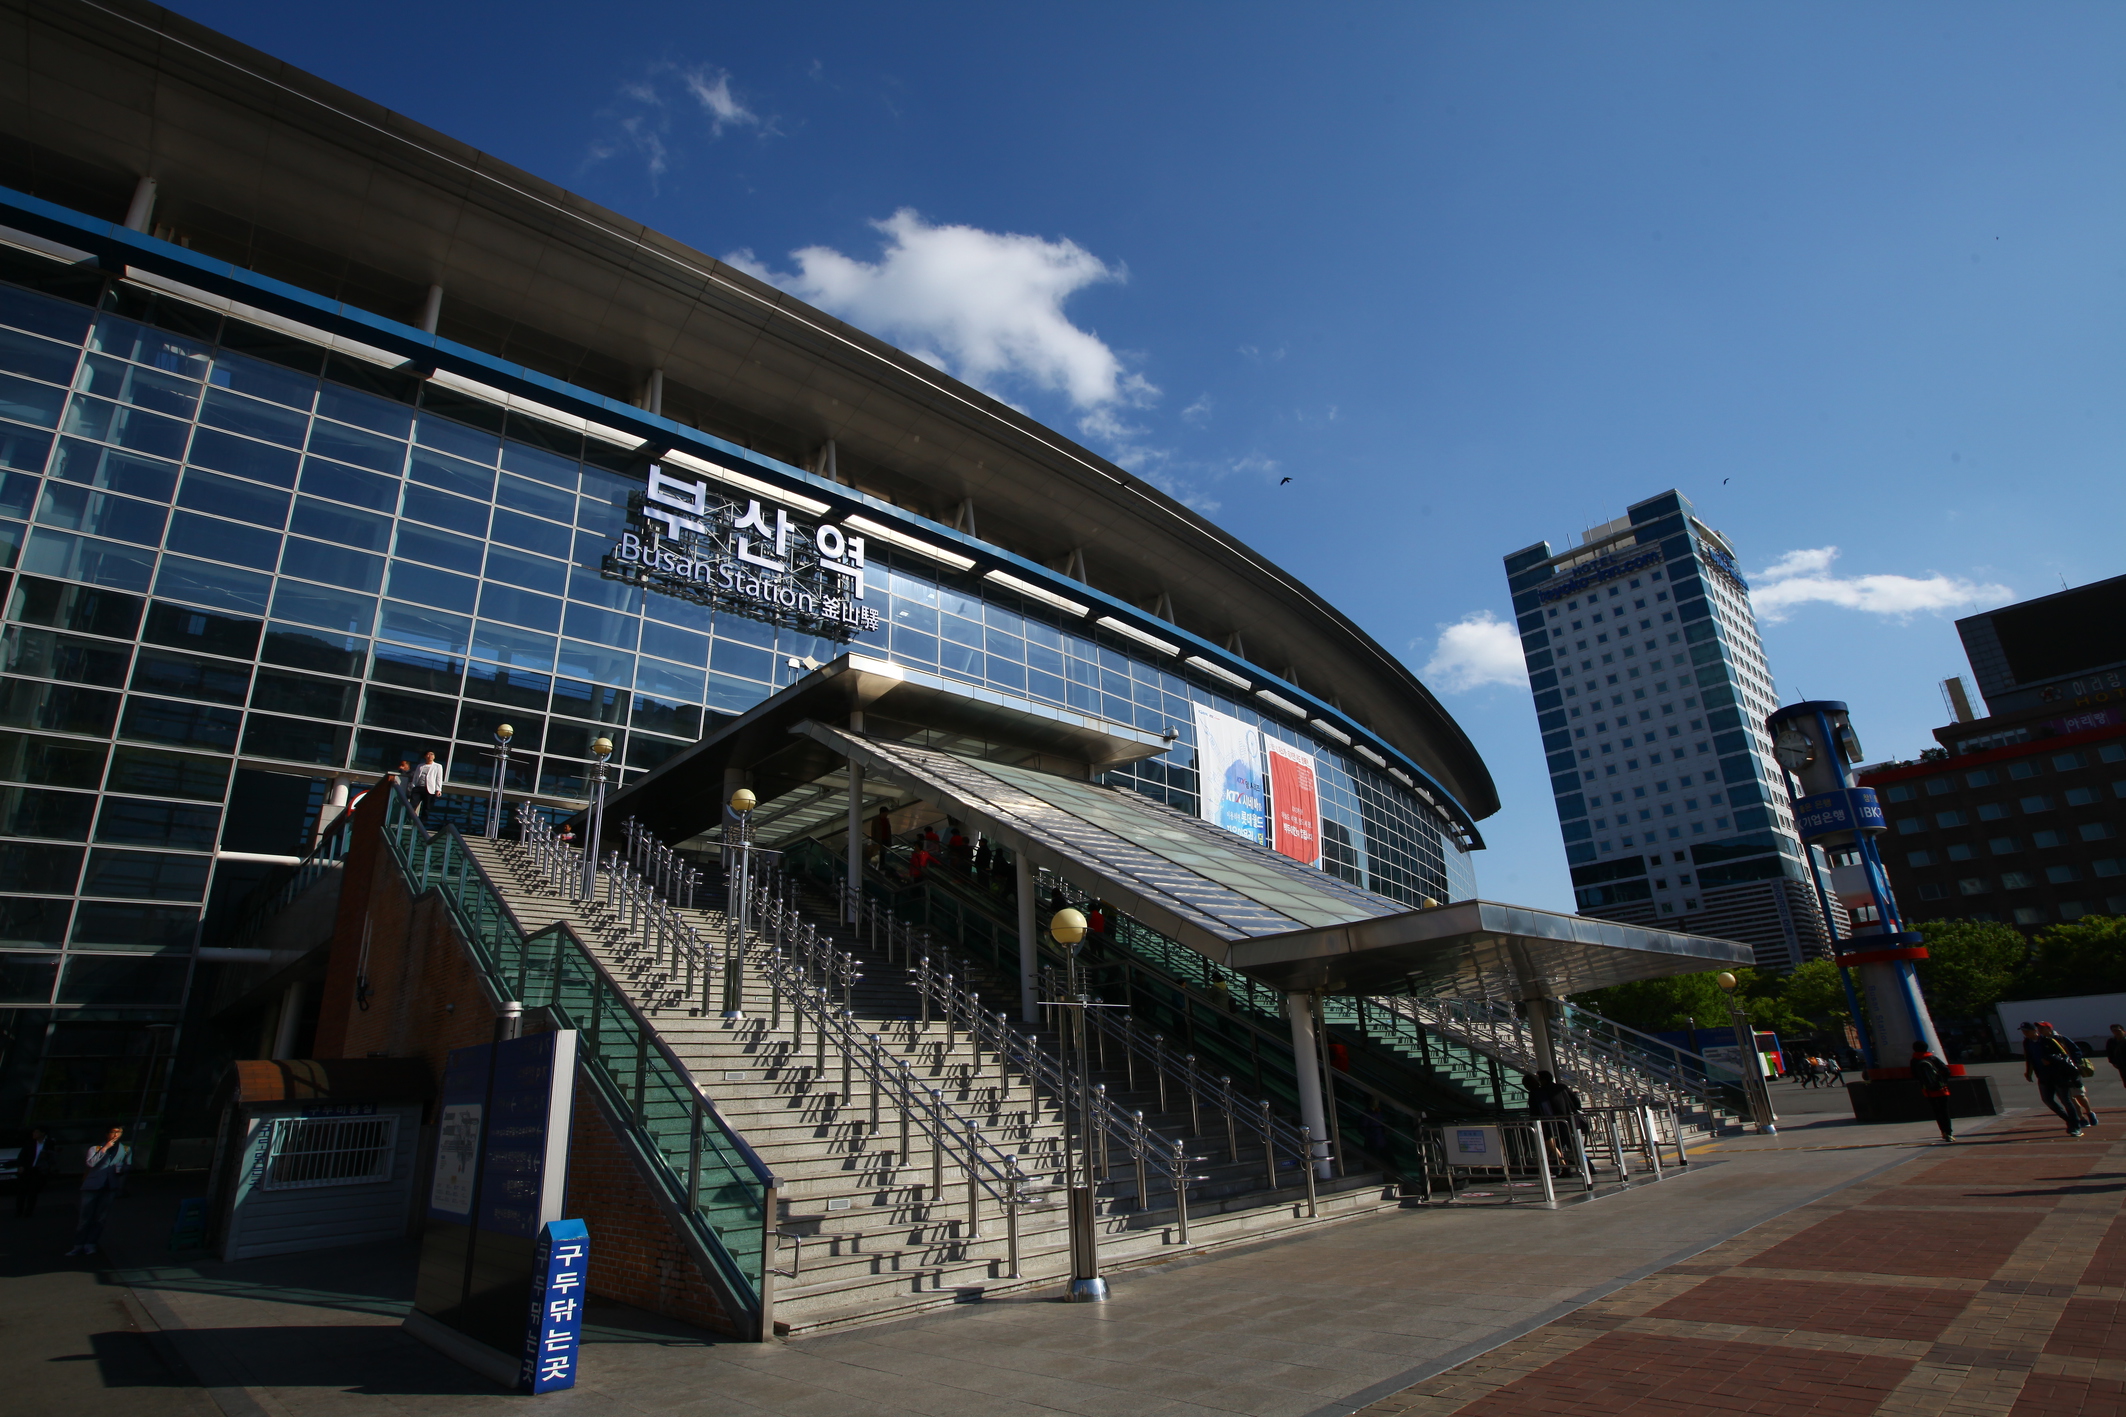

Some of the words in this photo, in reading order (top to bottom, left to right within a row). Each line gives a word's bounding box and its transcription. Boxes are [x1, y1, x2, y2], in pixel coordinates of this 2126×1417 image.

[642, 464, 865, 600] 부산역
[621, 532, 711, 583] Busan
[718, 563, 813, 612] Station
[820, 594, 879, 632] 釜山驛
[1538, 551, 1660, 603] toyoko-inn.com
[1572, 555, 1617, 577] HOTEL
[2073, 672, 2121, 696] 아리랑
[2067, 712, 2106, 730] 아리랑
[1814, 798, 1832, 809] 은행
[1868, 985, 1880, 1012] Busan
[1875, 1014, 1889, 1046] Station
[309, 1103, 373, 1116] 구두미용실
[522, 1242, 549, 1385] 구두닦는곳
[541, 1244, 583, 1383] 구두닦는곳
